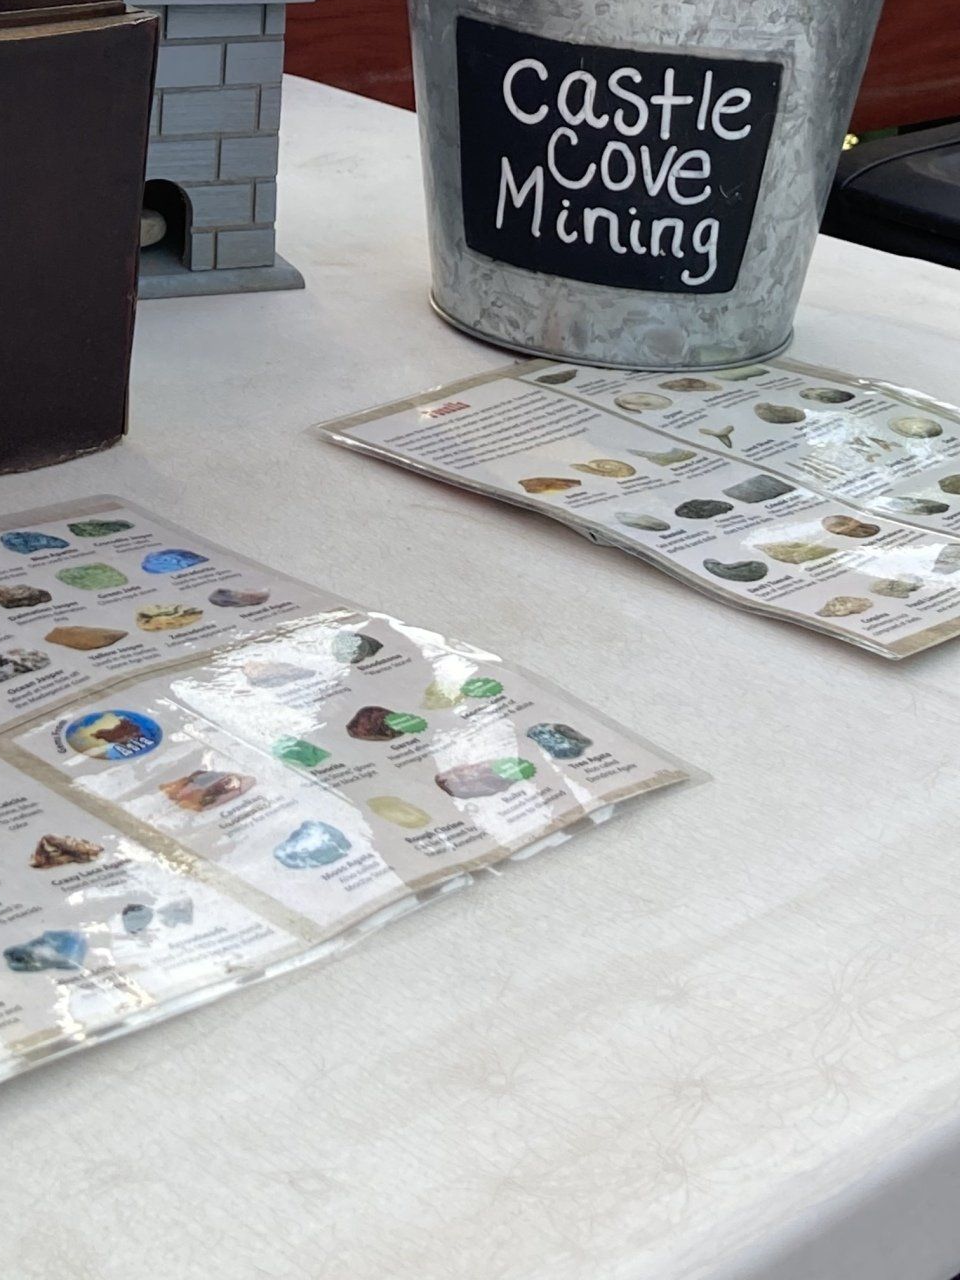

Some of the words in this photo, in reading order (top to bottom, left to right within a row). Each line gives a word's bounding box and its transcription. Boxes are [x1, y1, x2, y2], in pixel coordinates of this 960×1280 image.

[547, 127, 711, 205] Cove
[496, 156, 719, 285] Mining
[7, 678, 35, 696] Ocean
[37, 669, 64, 684] Jasper
[113, 735, 156, 758] Asia
[52, 871, 80, 888] Crazy
